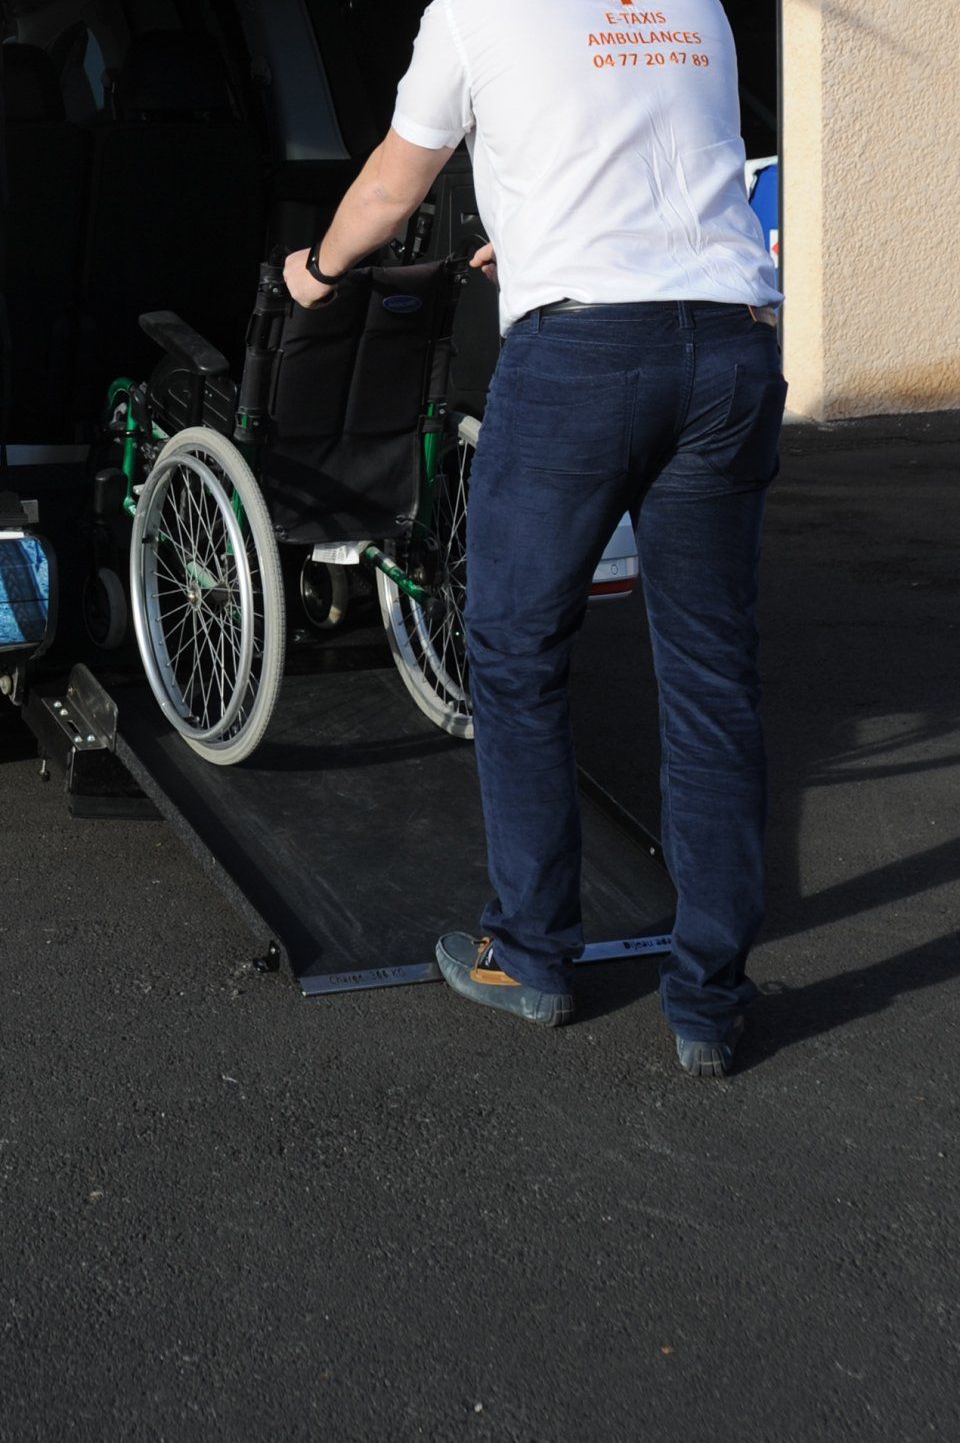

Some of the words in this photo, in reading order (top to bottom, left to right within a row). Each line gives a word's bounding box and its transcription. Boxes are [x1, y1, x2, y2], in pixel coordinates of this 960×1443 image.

[605, 11, 667, 25] E-TAXIS
[587, 30, 702, 46] AMBULANCES
[592, 54, 615, 69] 04
[618, 53, 638, 66] 77
[645, 52, 665, 66] 20
[669, 51, 687, 64] 47
[691, 53, 709, 68] 89
